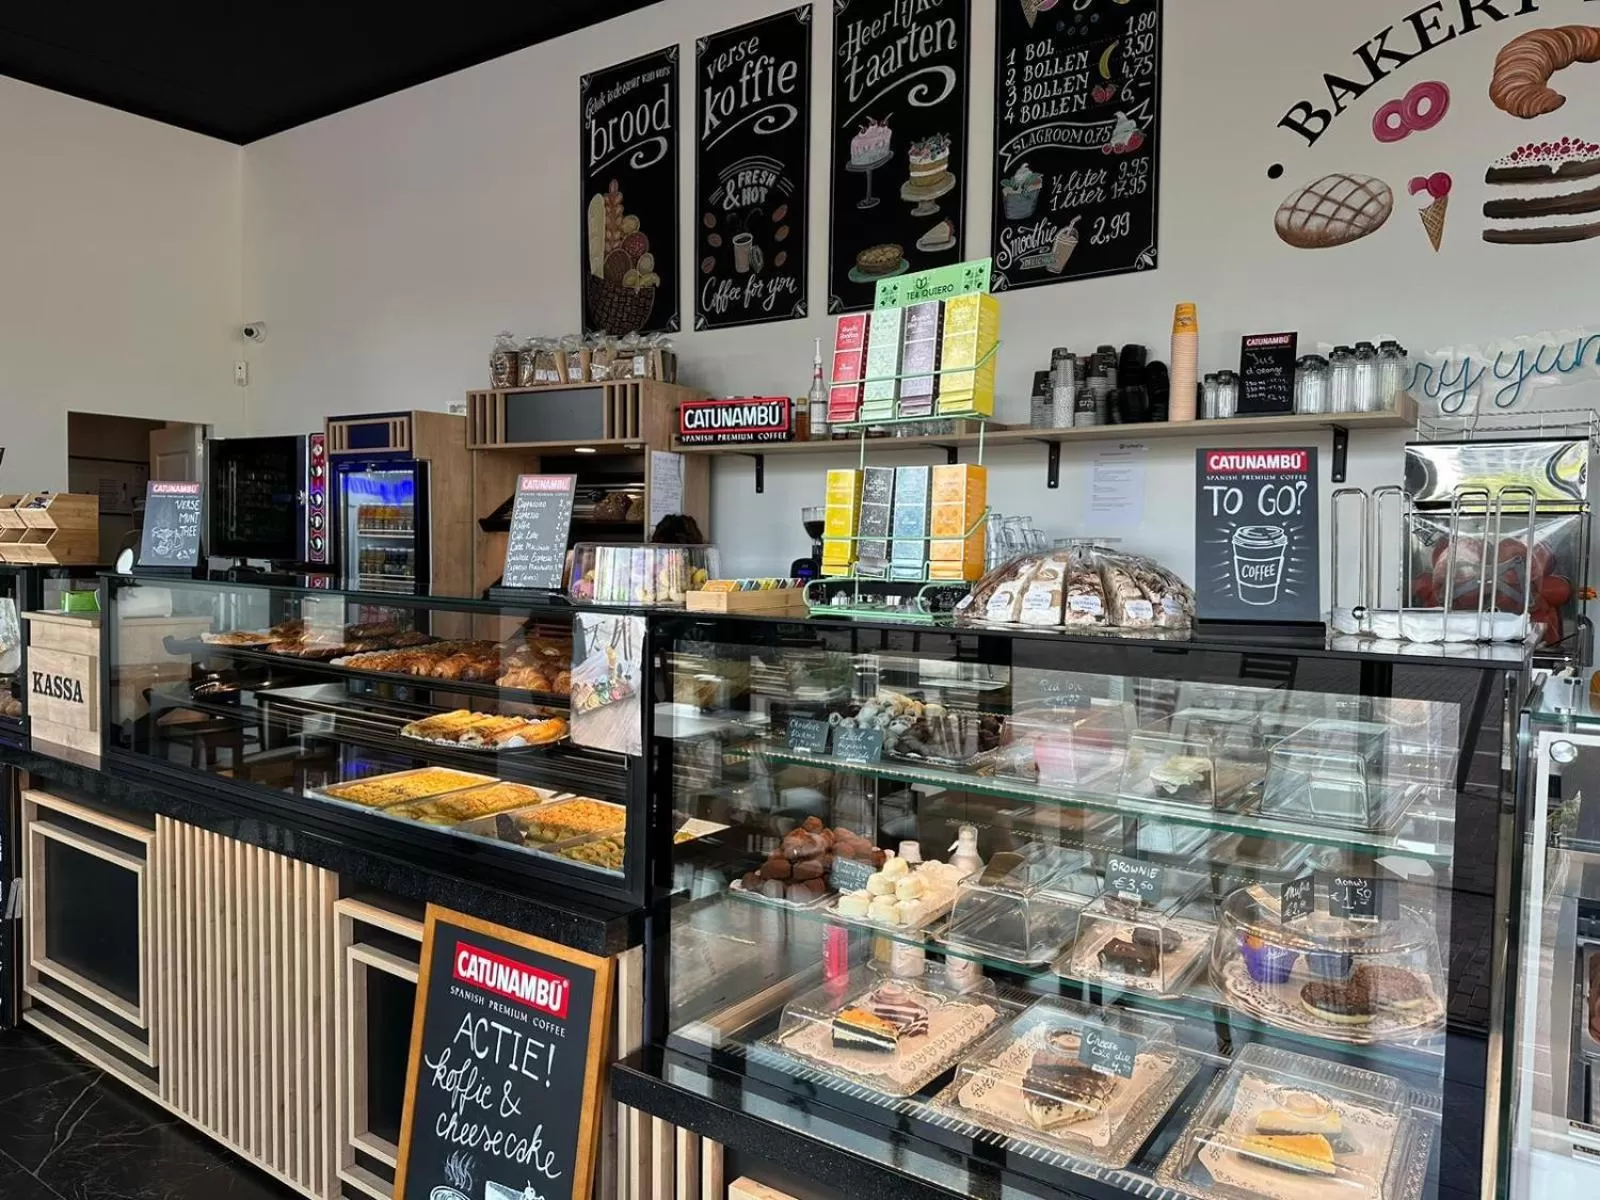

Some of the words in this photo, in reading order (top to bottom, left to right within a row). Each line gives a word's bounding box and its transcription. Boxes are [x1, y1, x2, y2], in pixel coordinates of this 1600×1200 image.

[839, 0, 944, 67] Heerlij
[707, 36, 760, 80] verse
[844, 18, 957, 103] taarten
[1005, 68, 1016, 86] 2
[1023, 50, 1089, 82] BOLLEN
[1006, 47, 1016, 66] 1
[1025, 39, 1055, 61] BOL
[701, 55, 798, 140] koffie
[1005, 85, 1017, 107] 3
[1021, 71, 1090, 103] BOLLEN
[589, 83, 671, 167] brood
[1004, 107, 1015, 125] 4
[1019, 93, 1088, 124] BOLLEN
[1012, 128, 1083, 154] SLAGROOM
[723, 179, 740, 210] &
[741, 186, 769, 206] HOT
[737, 170, 777, 188] FRESH
[1064, 168, 1108, 193] liter
[1059, 187, 1107, 209] liter
[995, 216, 1058, 270] Smoothie
[744, 273, 764, 308] for
[763, 276, 797, 311] you
[921, 284, 955, 298] QUIERO
[682, 434, 714, 443] SPANISH
[717, 433, 754, 441] PREMIUM
[758, 431, 787, 440] COFFEE
[175, 499, 200, 510] VERSE
[1203, 485, 1243, 516] TO
[1258, 480, 1308, 516] GO?
[1241, 564, 1276, 581] COFFEE
[32, 671, 84, 703] KASSA
[1109, 859, 1160, 879] BROWNIE
[450, 985, 485, 1005] SPANISH
[488, 1000, 528, 1022] PREMIUM
[532, 1017, 566, 1037] COFFEE
[453, 1011, 556, 1088] ACTIE!
[425, 1047, 493, 1115] koffie
[500, 1080, 522, 1118] &
